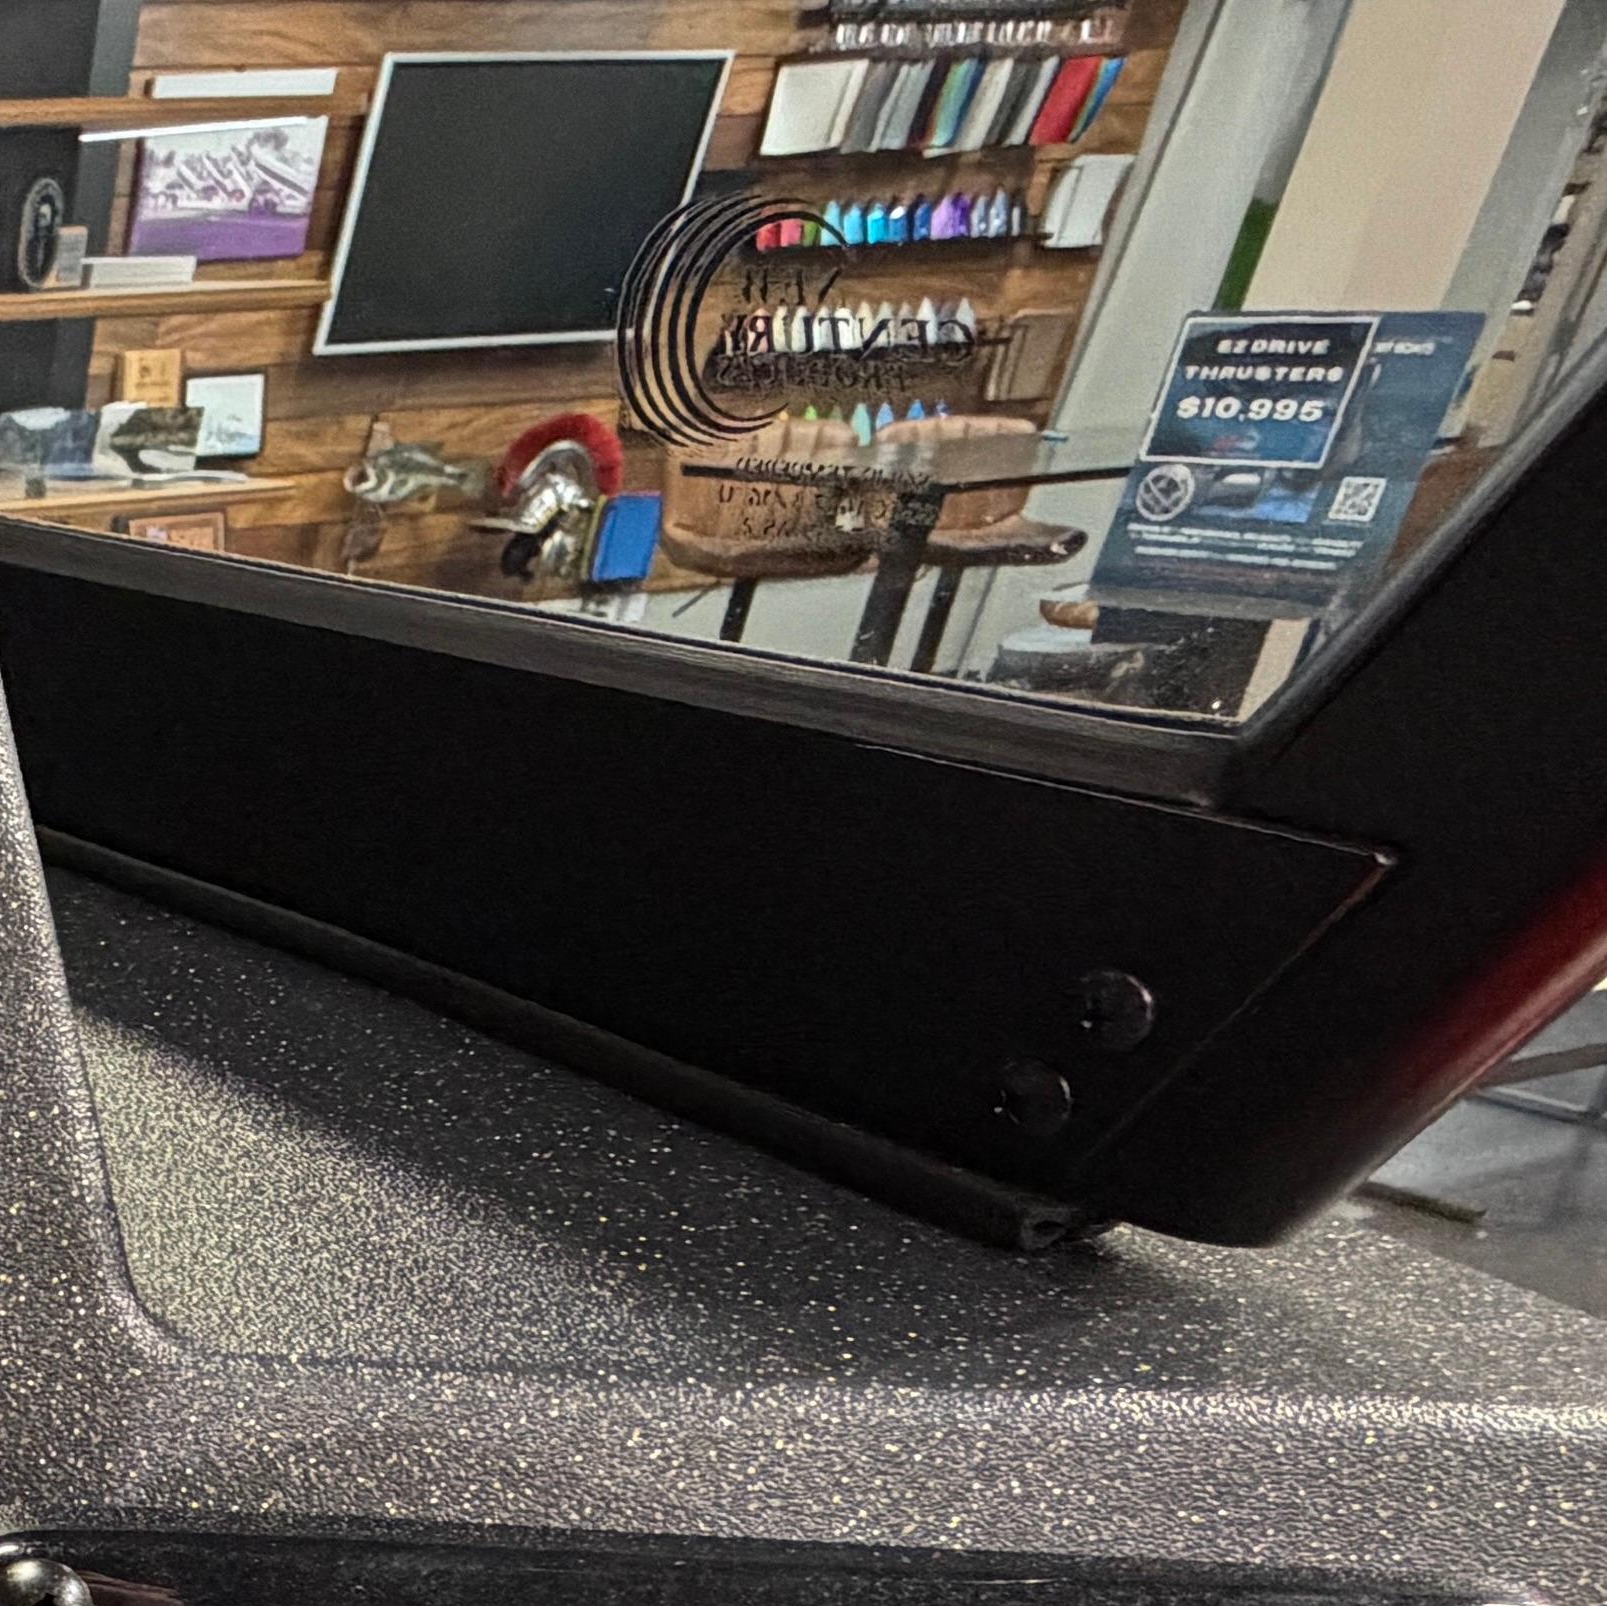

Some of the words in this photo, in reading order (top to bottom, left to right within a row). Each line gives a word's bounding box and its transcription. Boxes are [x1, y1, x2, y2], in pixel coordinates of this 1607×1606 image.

[1250, 338, 1330, 355] DRIVE
[1185, 365, 1344, 382] THRUSTERS
[1176, 396, 1325, 422] $10,995
